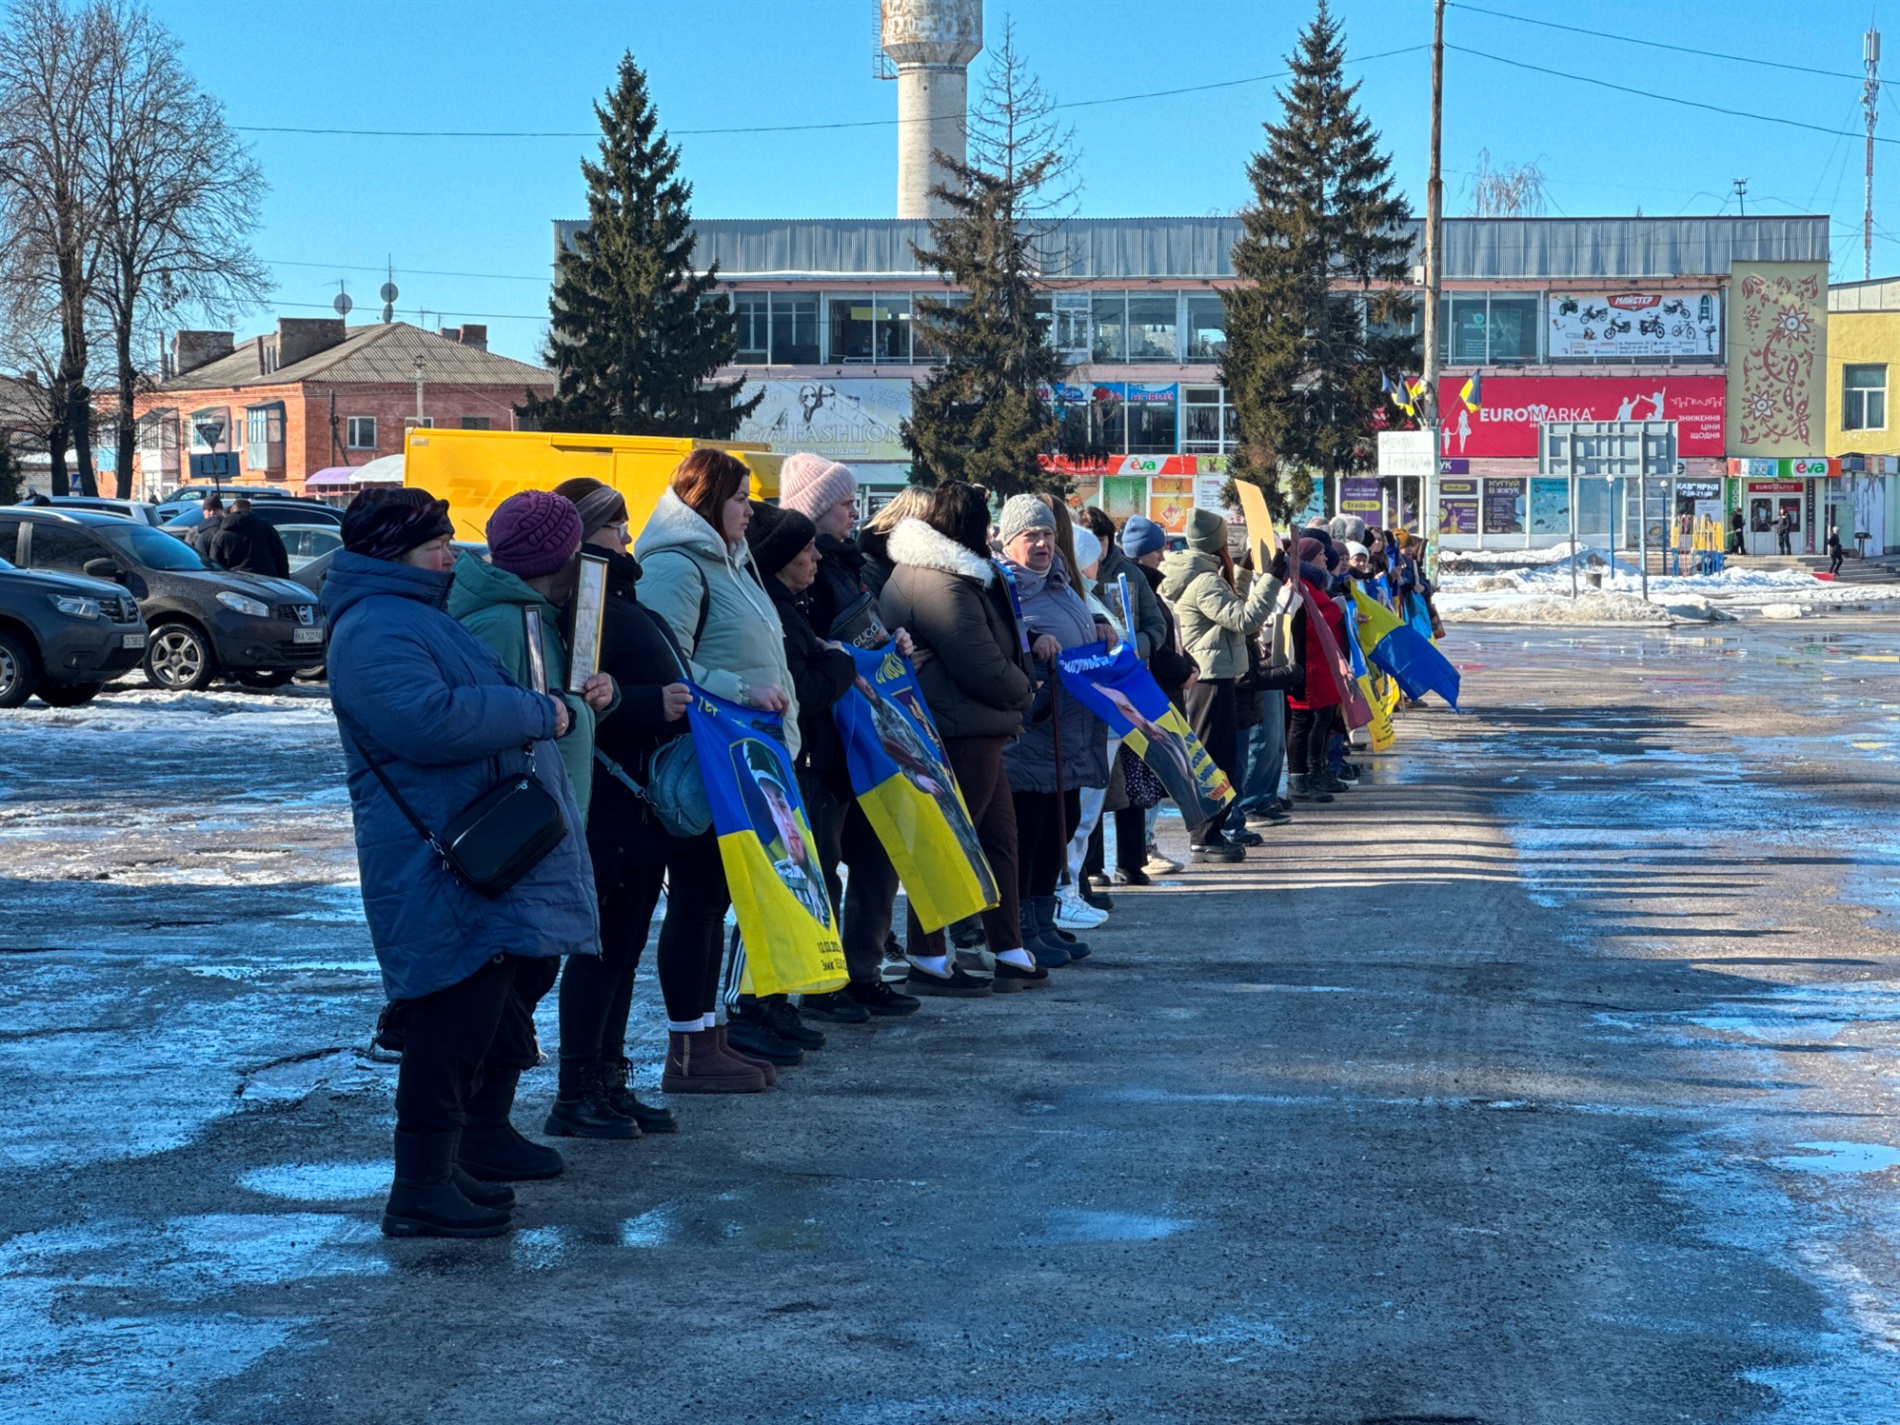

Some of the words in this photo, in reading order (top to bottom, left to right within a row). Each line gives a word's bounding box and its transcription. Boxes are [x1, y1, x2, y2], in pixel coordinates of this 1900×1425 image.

[1700, 423, 1721, 431] ЦІНИ
[1690, 432, 1721, 440] ЩОДНЯ
[1488, 478, 1520, 487] КУПУЙ
[1346, 501, 1377, 509] Trade-in
